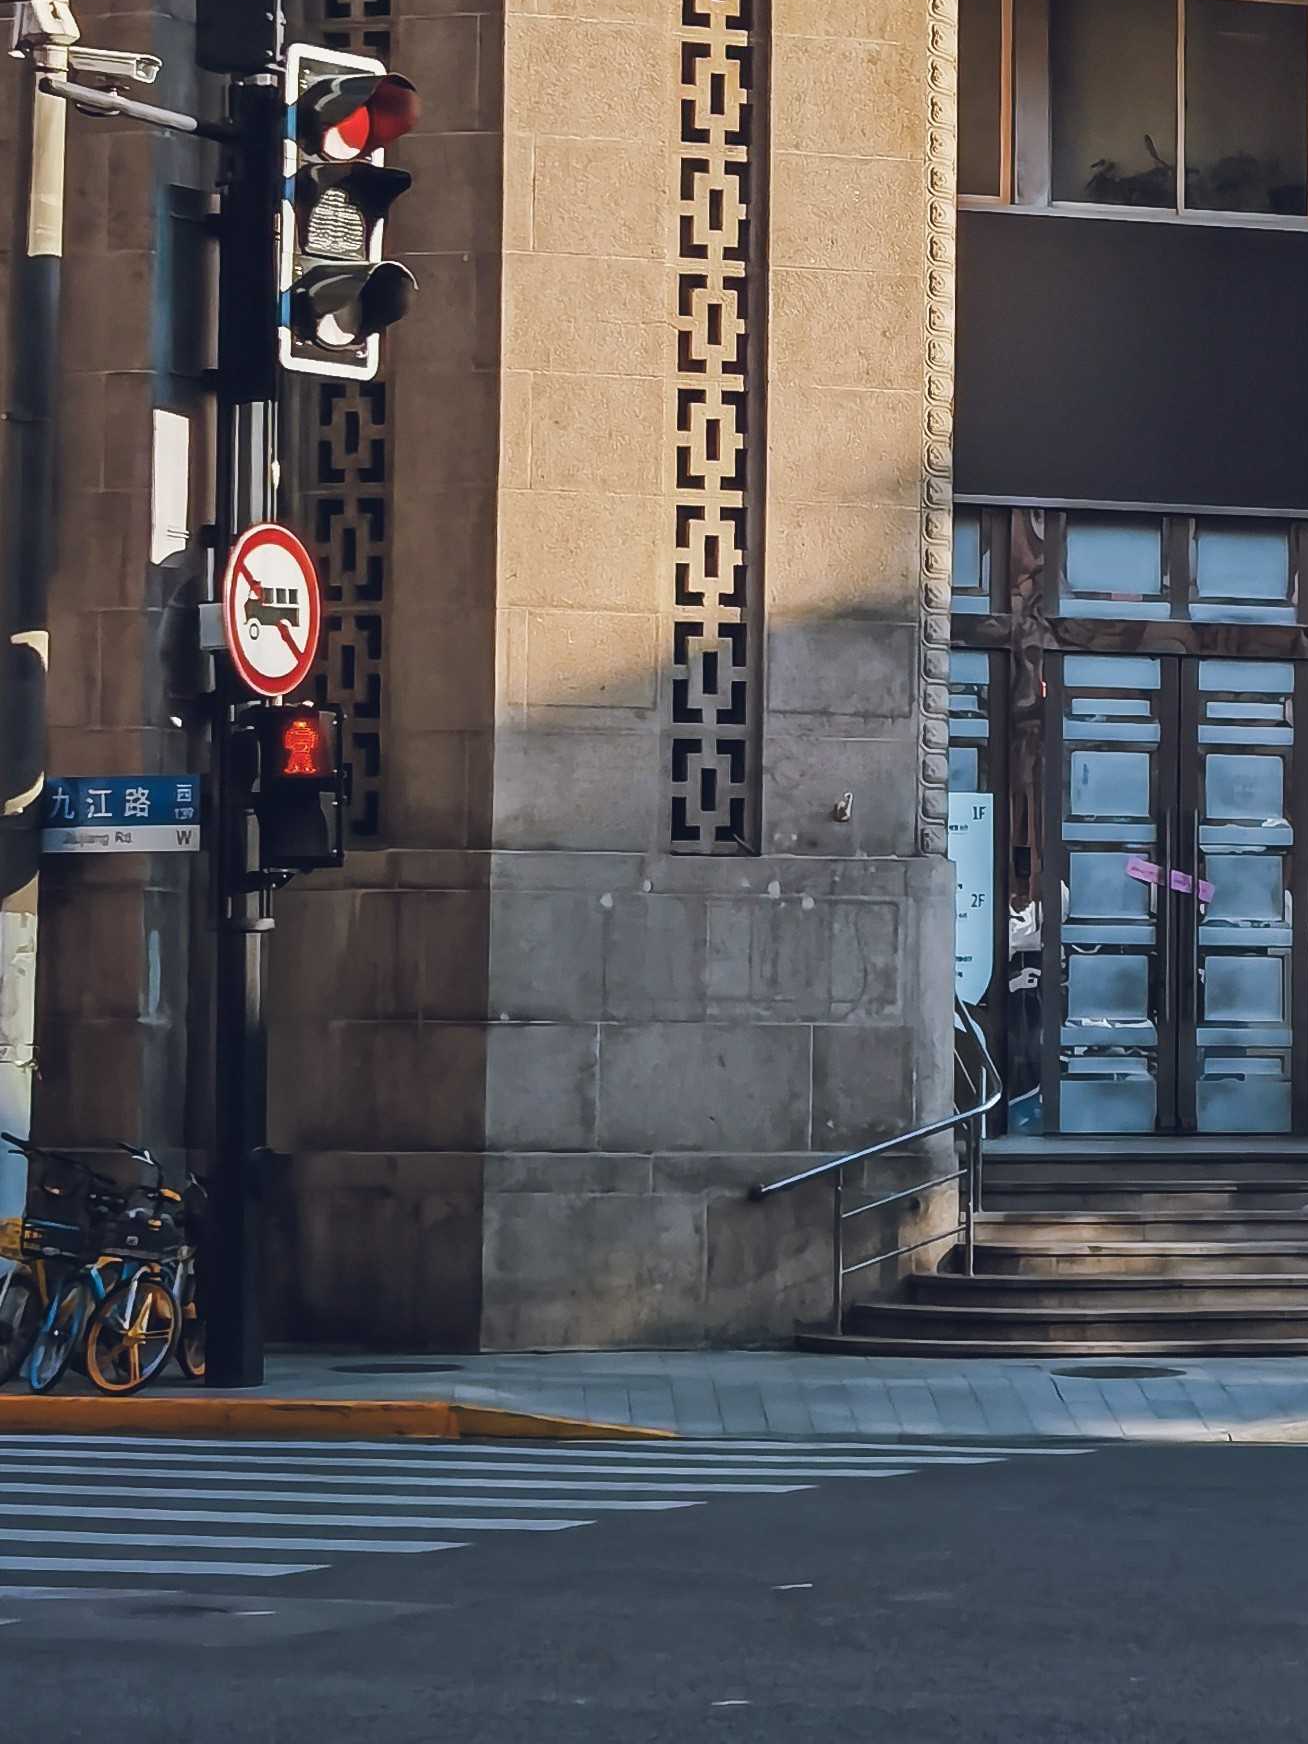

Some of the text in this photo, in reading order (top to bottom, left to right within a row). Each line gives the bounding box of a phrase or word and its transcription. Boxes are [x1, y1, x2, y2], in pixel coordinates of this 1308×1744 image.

[50, 786, 152, 820] 九江路
[972, 806, 987, 820] 1F
[176, 830, 192, 846] W
[970, 893, 986, 908] 2F
